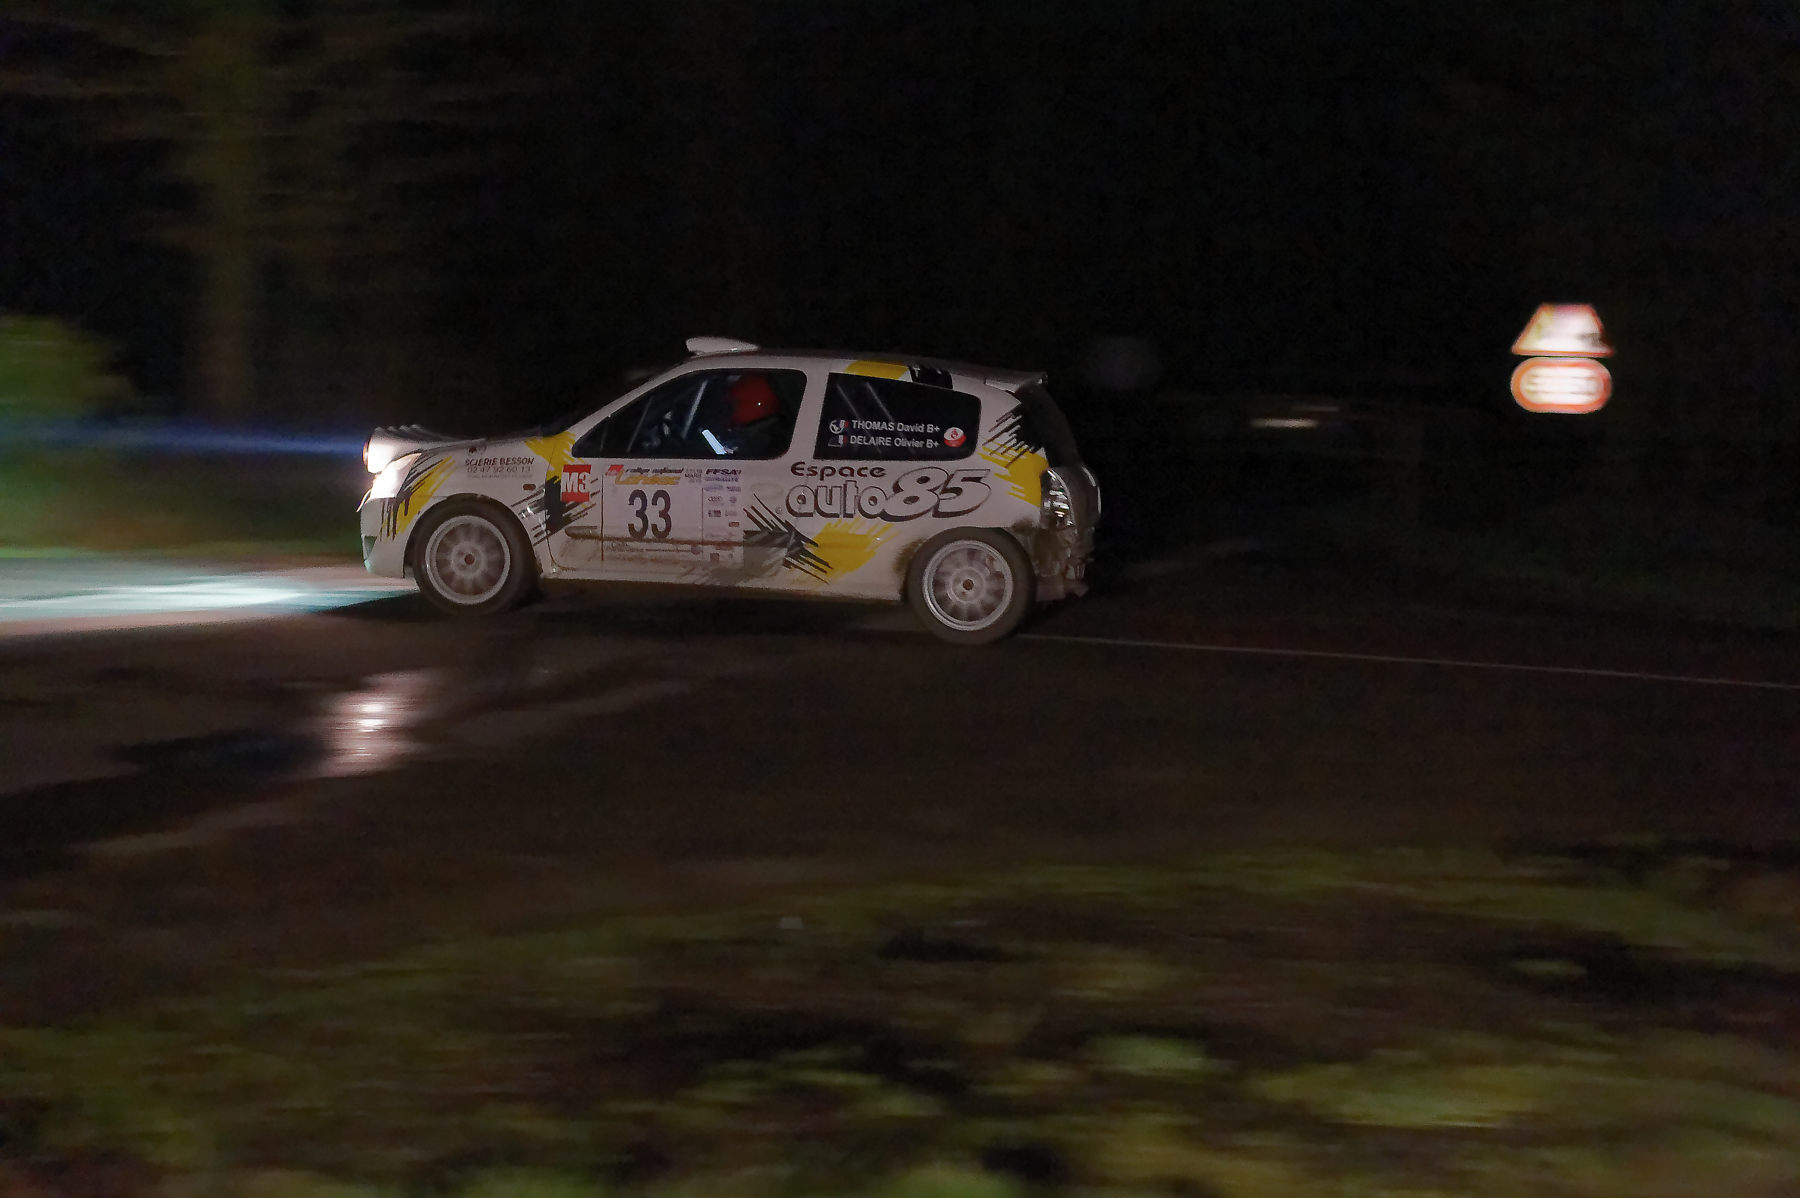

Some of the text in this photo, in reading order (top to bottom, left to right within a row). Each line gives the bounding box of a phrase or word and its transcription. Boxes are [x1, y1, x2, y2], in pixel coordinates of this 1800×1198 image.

[851, 420, 895, 432] THOMAS
[896, 422, 925, 433] David
[850, 435, 892, 447] DELAIRE
[894, 437, 925, 448] Olivier
[499, 457, 535, 466] BESSON
[790, 461, 887, 481] Espace
[561, 471, 590, 493] M3
[628, 489, 672, 539] 33
